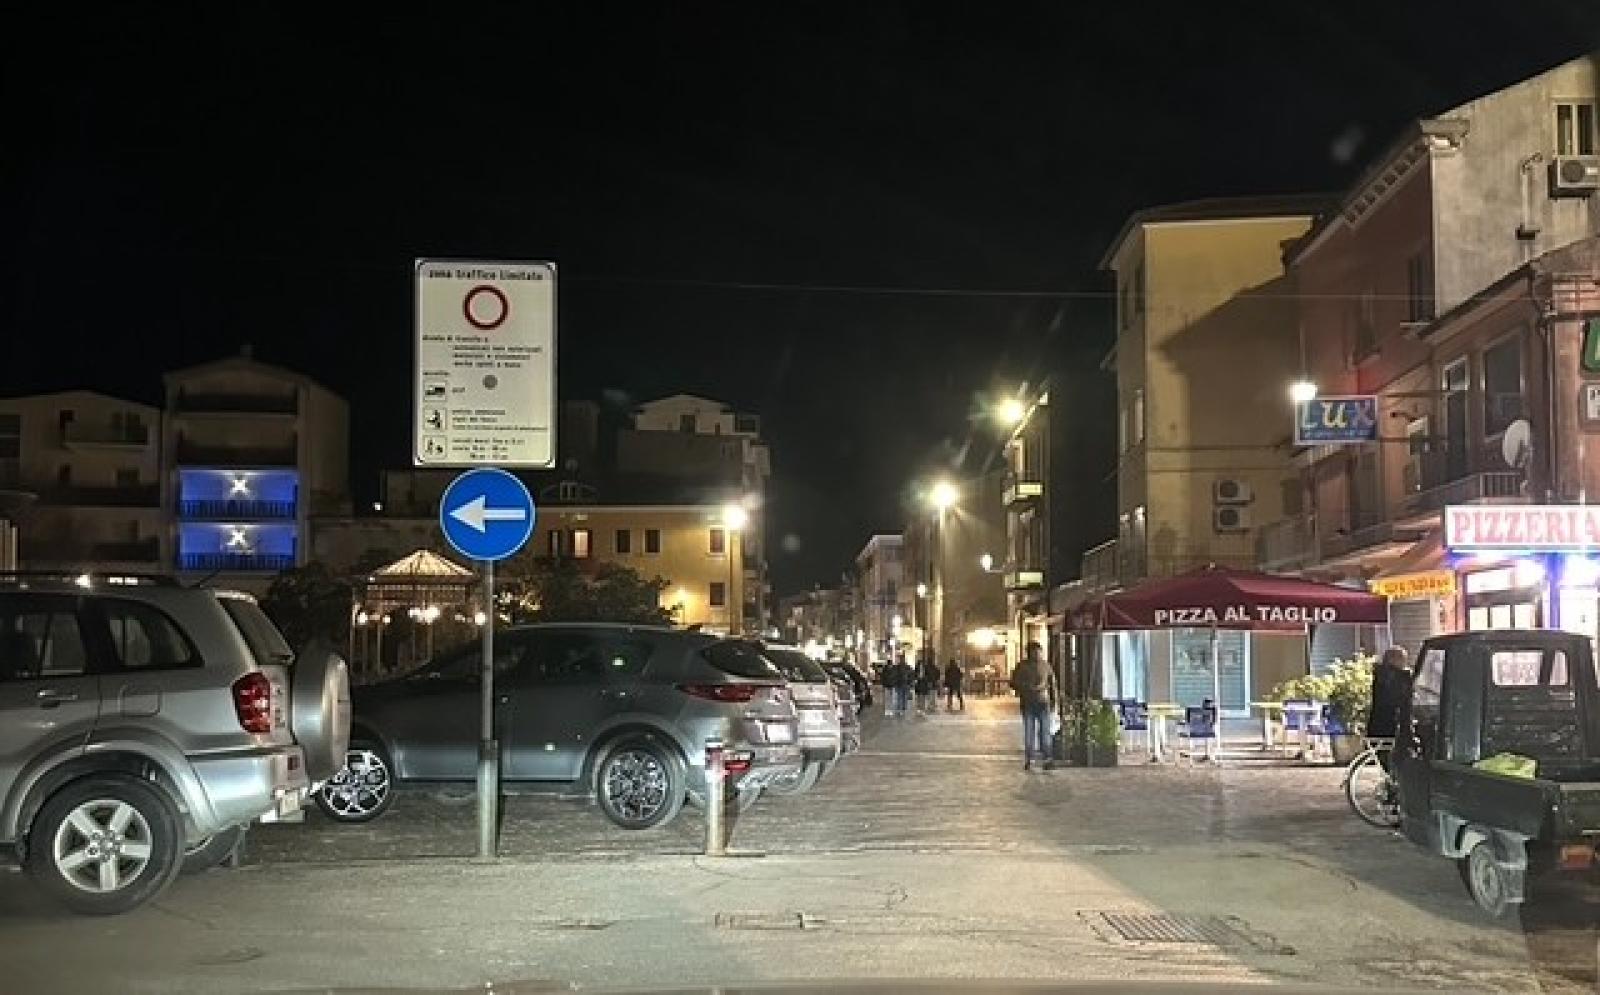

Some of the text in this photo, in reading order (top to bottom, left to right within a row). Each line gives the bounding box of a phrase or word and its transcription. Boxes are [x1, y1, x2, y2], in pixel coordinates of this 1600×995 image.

[1154, 604, 1337, 625] PIZZA AL TAGLIO
